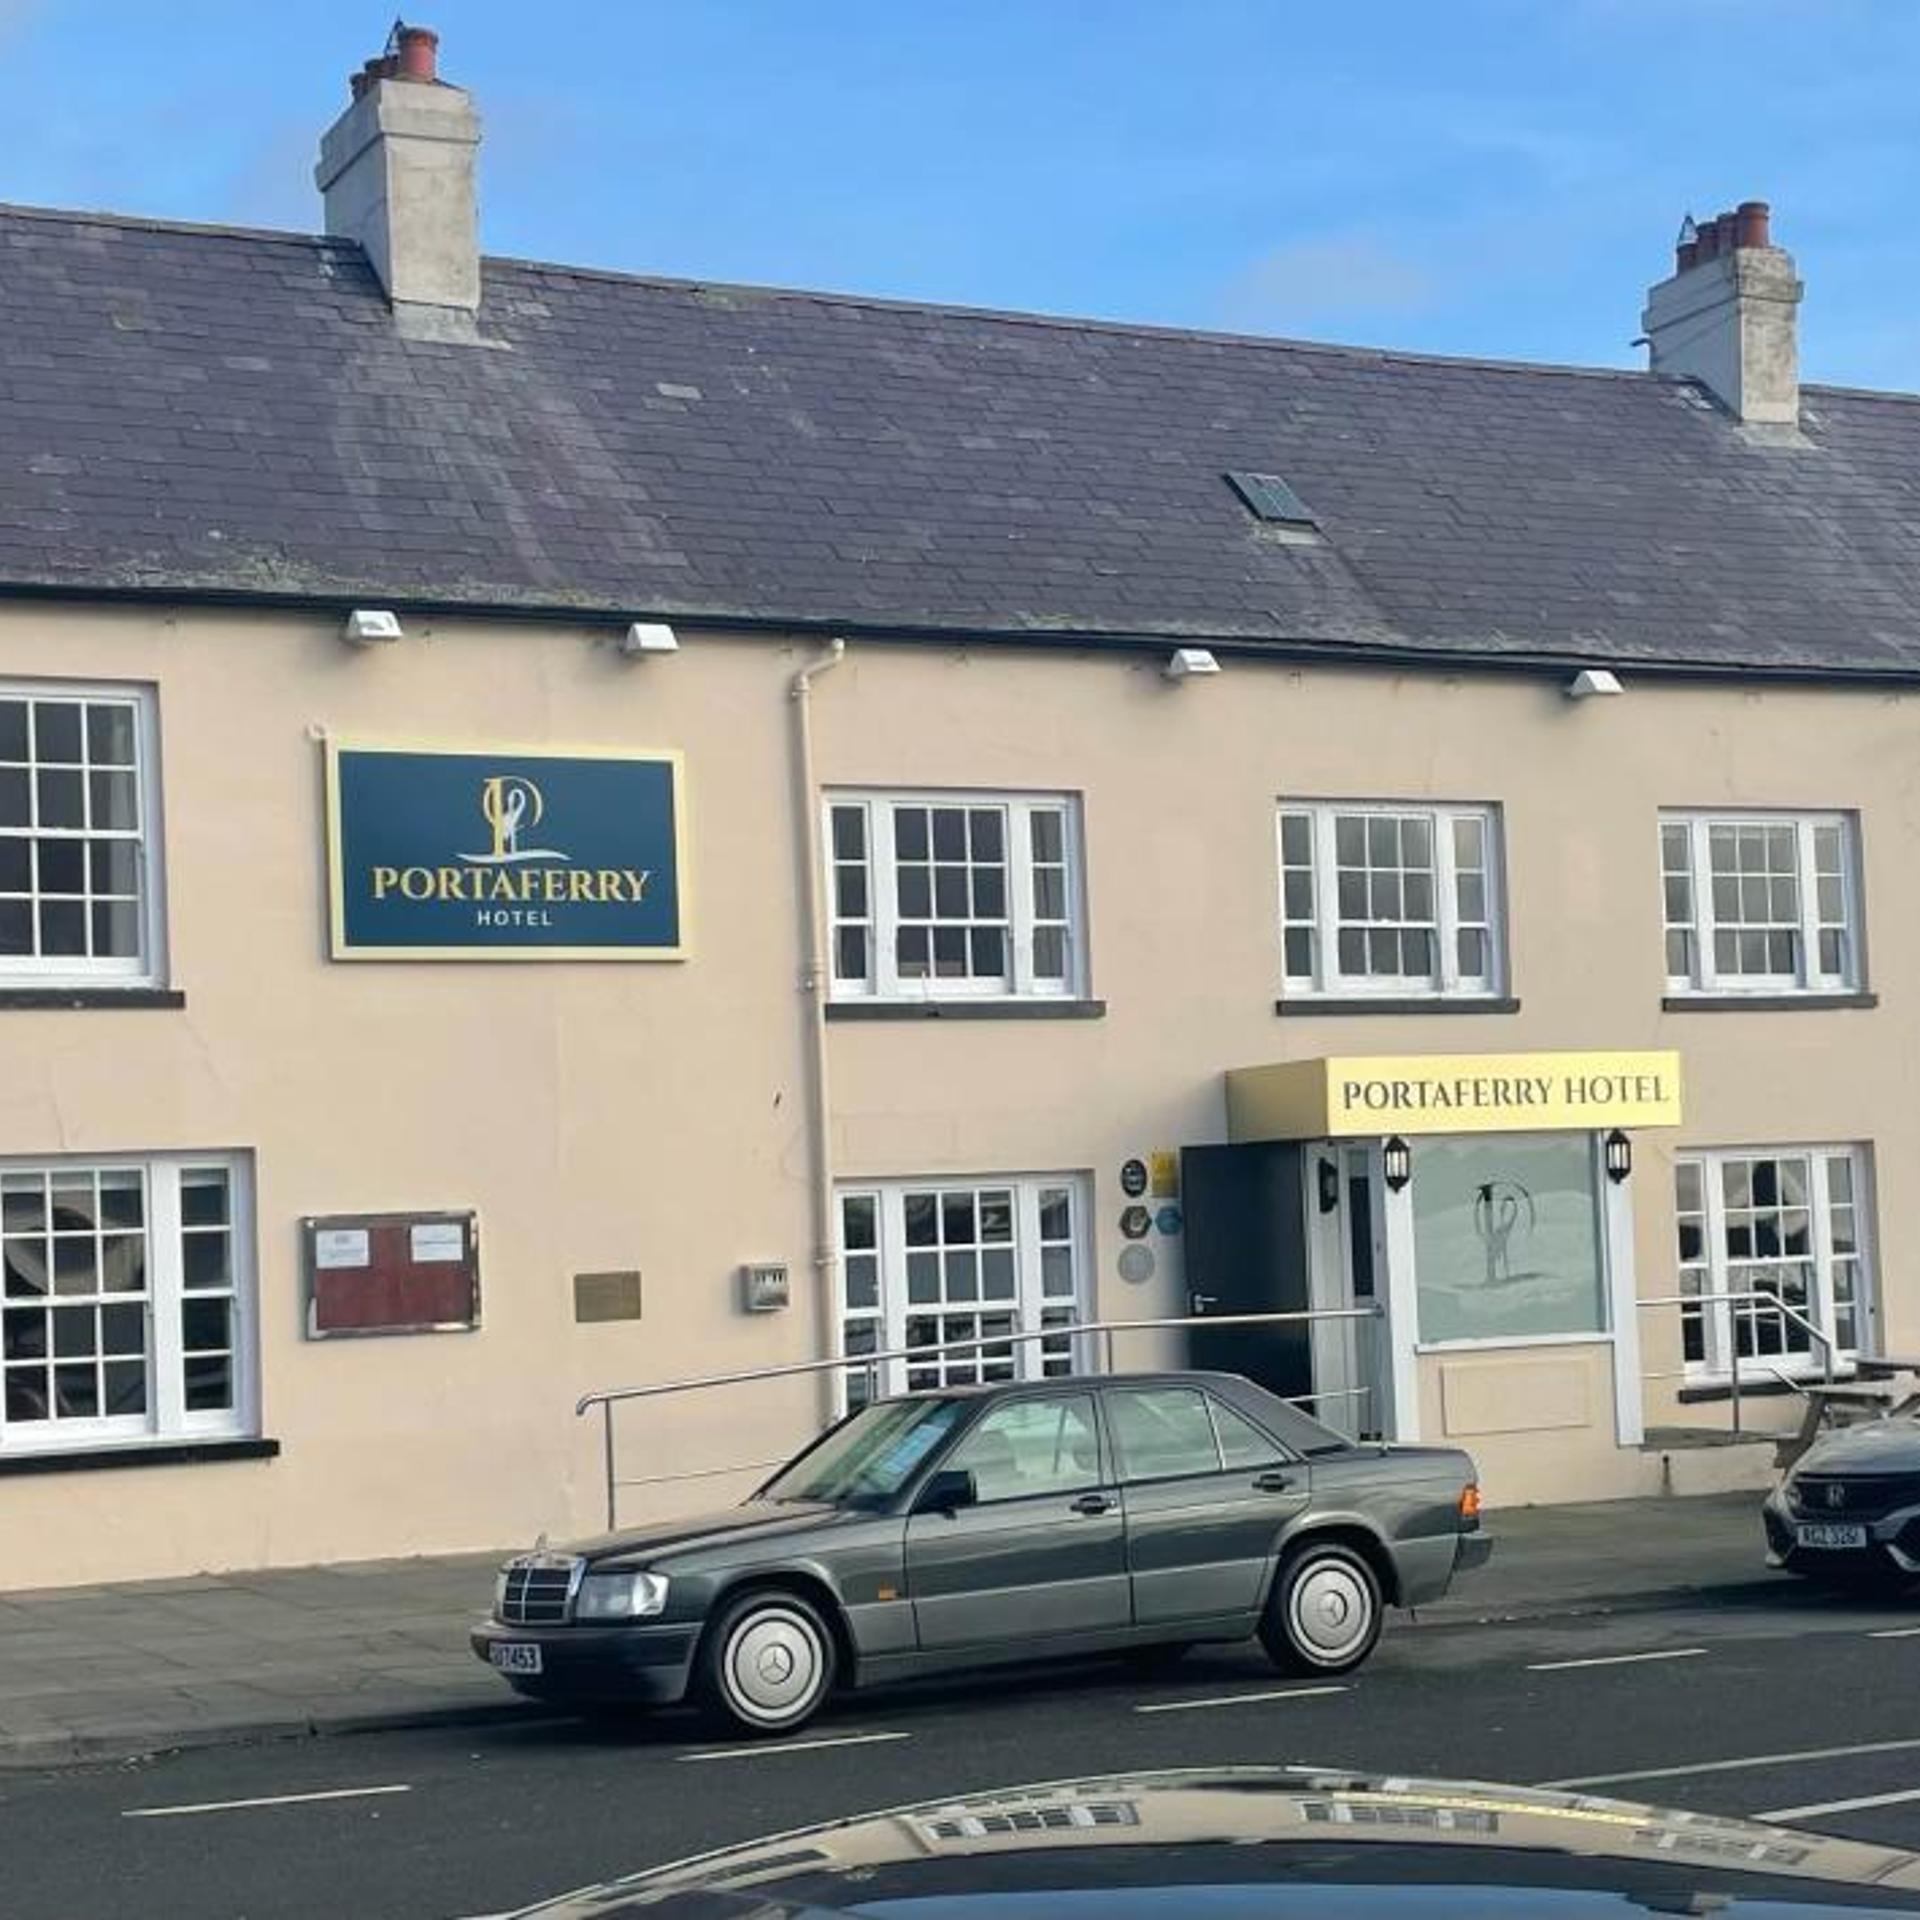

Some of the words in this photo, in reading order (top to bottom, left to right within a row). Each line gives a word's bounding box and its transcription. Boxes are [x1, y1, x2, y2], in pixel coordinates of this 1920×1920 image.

[372, 866, 651, 902] PORTAFERRY
[477, 910, 552, 926] HOTEL
[1344, 1077, 1552, 1110] PORTAFERRY
[1565, 1076, 1670, 1104] HOTEL
